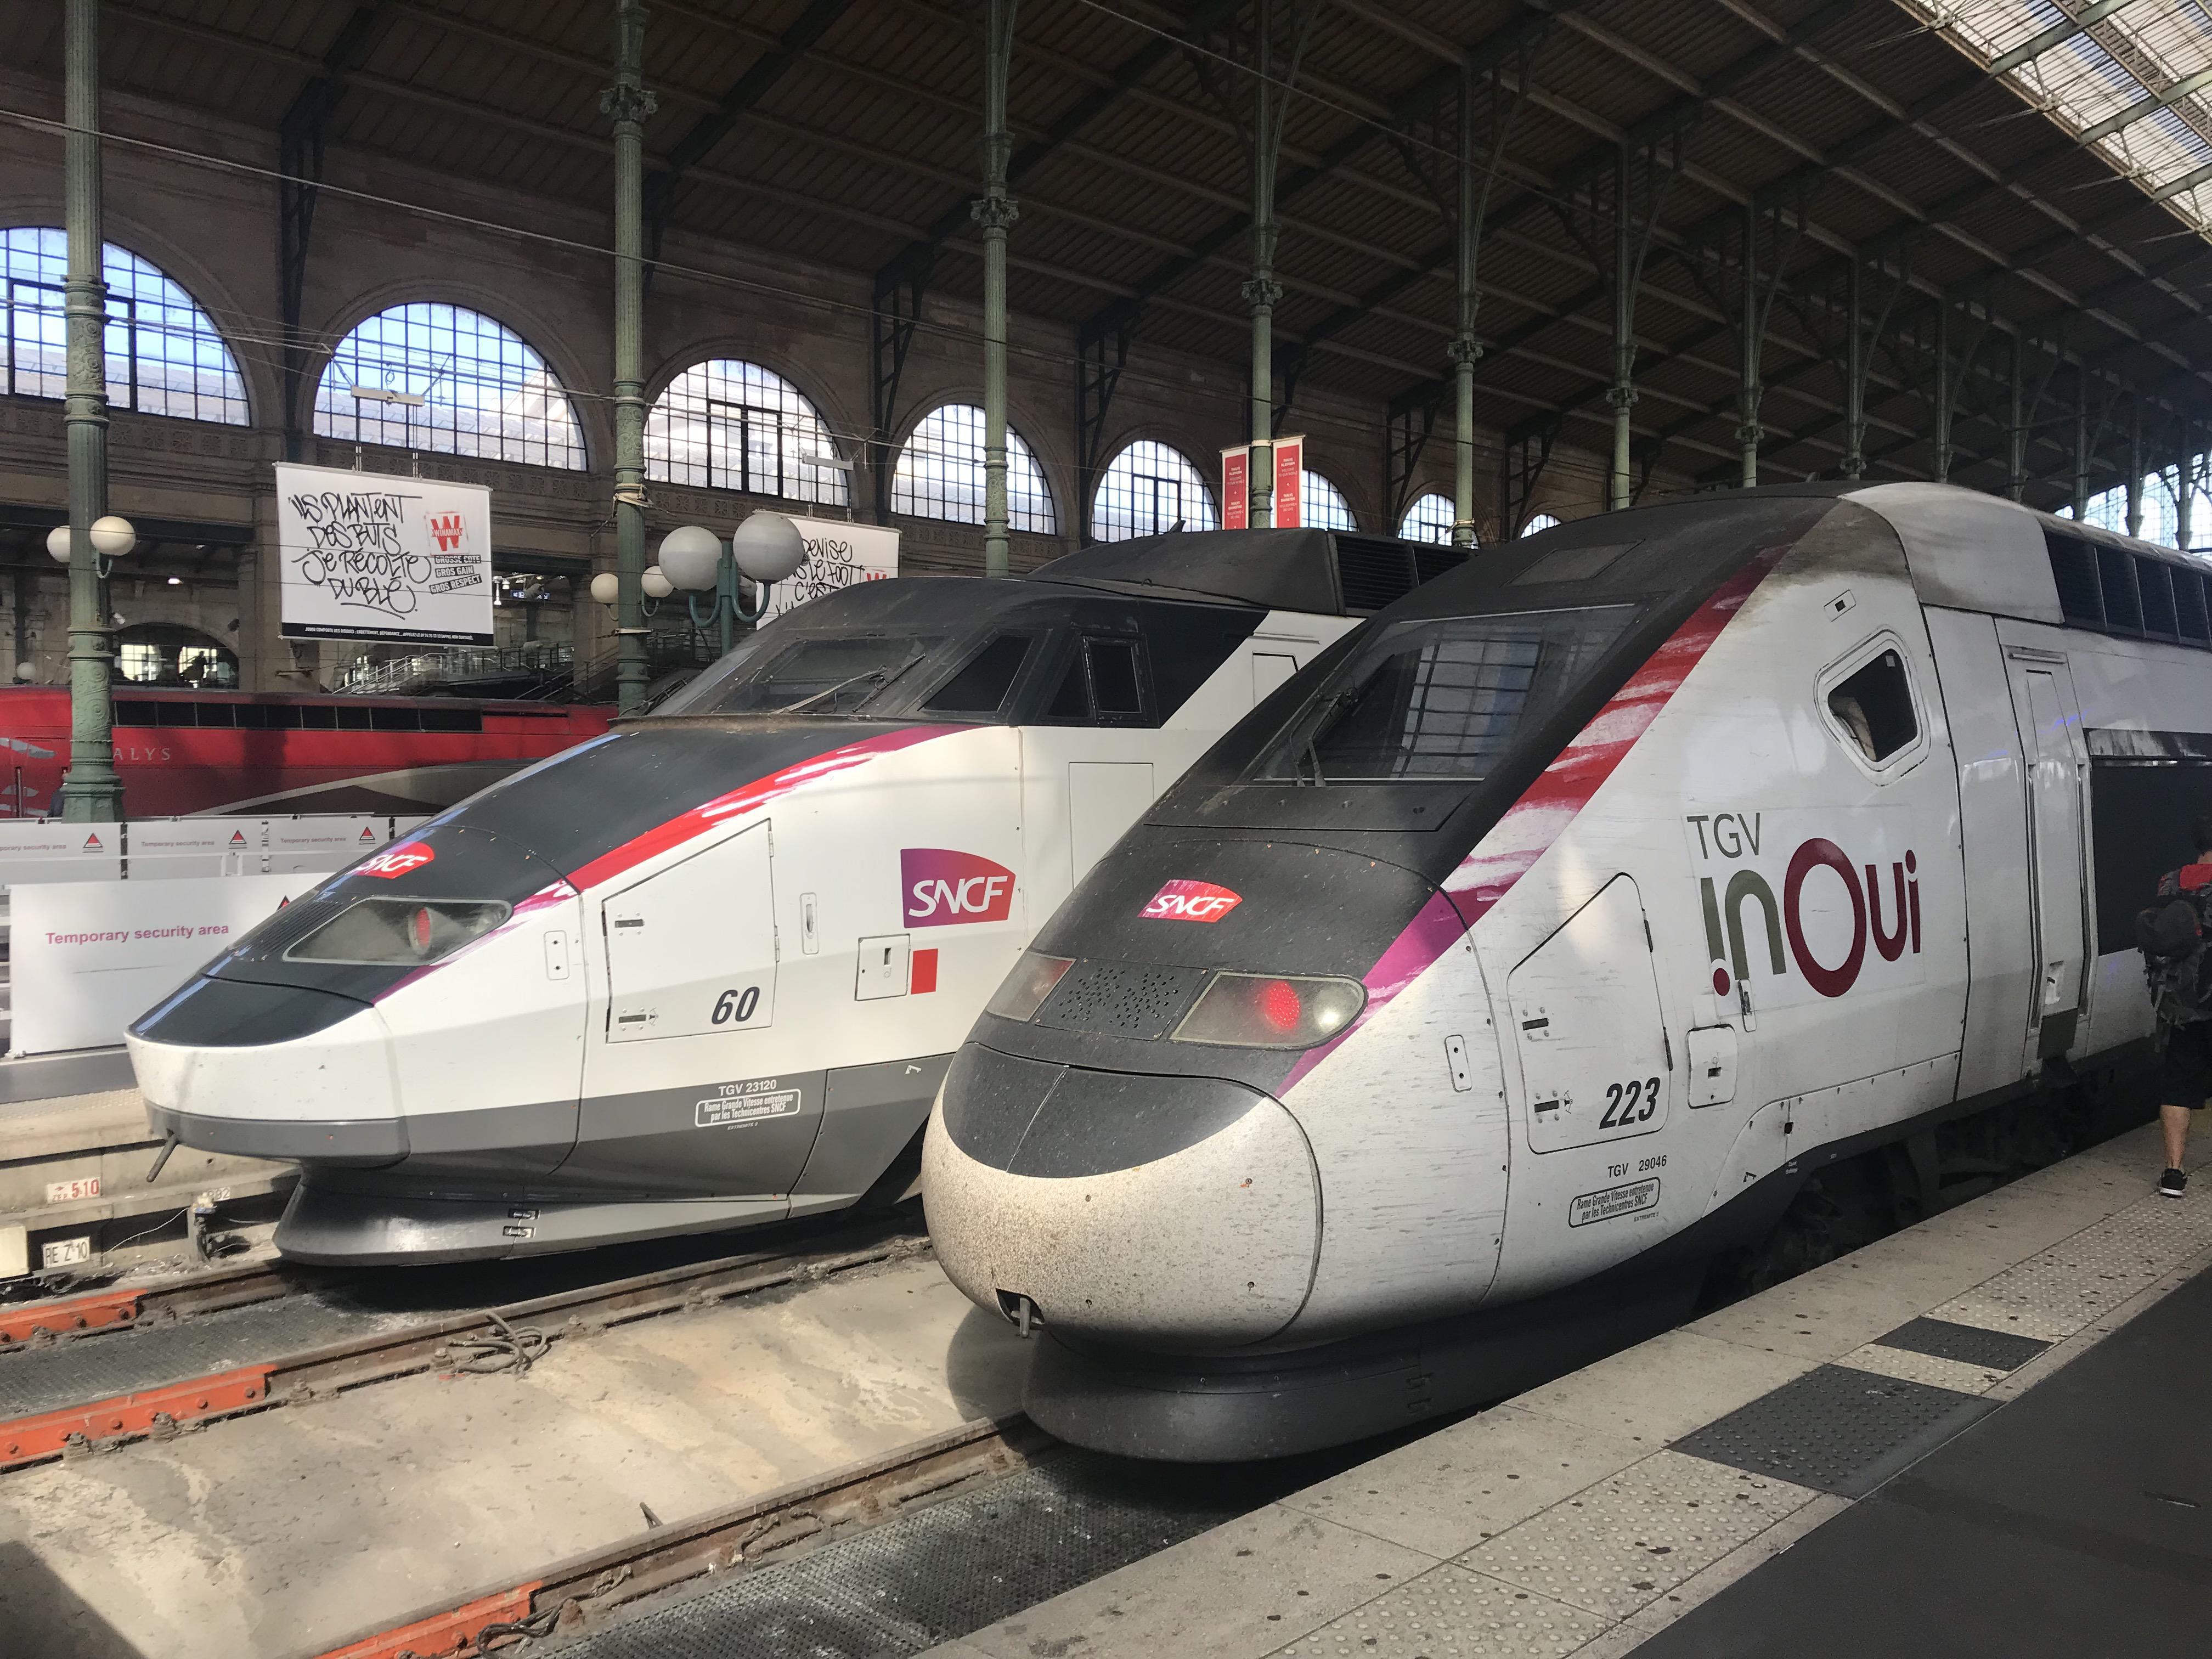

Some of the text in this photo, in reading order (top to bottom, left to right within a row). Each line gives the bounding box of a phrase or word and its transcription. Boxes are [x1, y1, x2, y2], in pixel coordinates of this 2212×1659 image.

[347, 522, 401, 556] BUTS
[435, 555, 481, 564] GROSSE COTE
[436, 565, 473, 577] GROS GAIN
[327, 577, 353, 600] DU
[430, 575, 481, 593] GROS RESPECT
[113, 748, 171, 760] ALYS
[1687, 812, 1760, 860] TGV
[907, 875, 1008, 917] SNCF
[1146, 895, 1235, 915] SNCF
[46, 924, 229, 945] Temporary security area
[712, 986, 760, 1025] 60
[718, 1079, 777, 1096] TGV 23120
[704, 1094, 793, 1112] Rame Grande Vitesse entretenue
[710, 1102, 786, 1123] par les Technicentres SNCF
[1599, 1077, 1661, 1130] 223
[1607, 1155, 1667, 1178] TGV 29046
[72, 1179, 99, 1198] 510
[1577, 1183, 1654, 1210] Rame Grande Vitesse entretenue
[1582, 1210, 1590, 1223] par
[1600, 1199, 1633, 1216] Technicentres
[1634, 1193, 1648, 1207] SNCF
